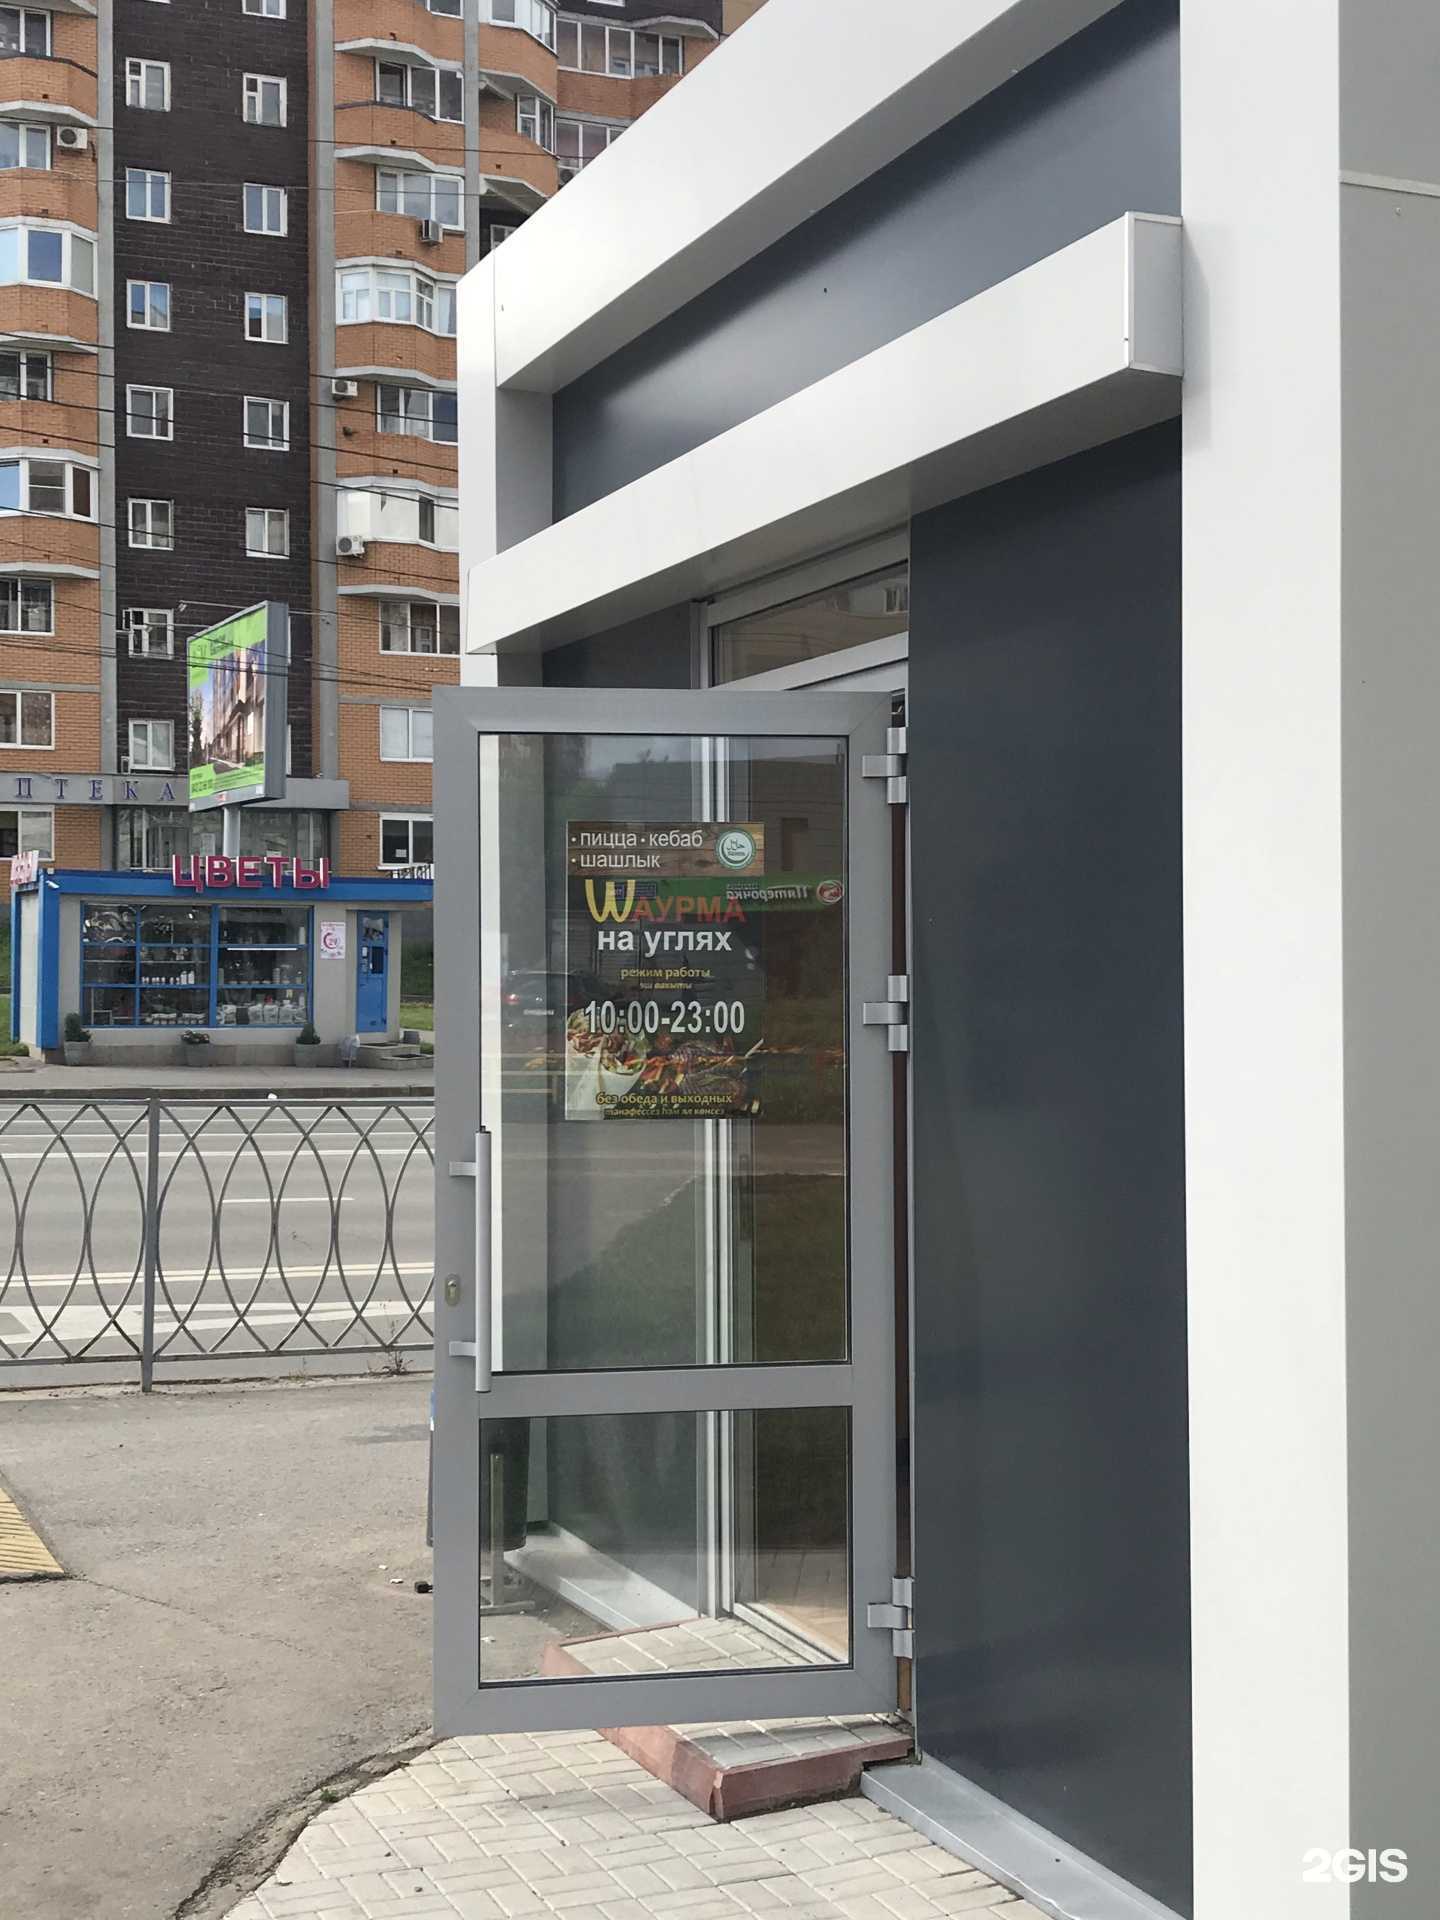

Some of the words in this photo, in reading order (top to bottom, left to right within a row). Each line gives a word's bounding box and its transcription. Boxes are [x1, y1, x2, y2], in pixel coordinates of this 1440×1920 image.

[580, 832, 637, 849] пицца
[649, 830, 703, 847] кебаб
[580, 854, 661, 868] шашлык
[172, 854, 331, 893] ЦВЕТЫ
[598, 930, 634, 951] на
[644, 931, 732, 958] углях
[621, 968, 662, 980] режим
[665, 967, 712, 980] работы
[585, 1000, 745, 1034] 10:00-23:00
[596, 1092, 619, 1104] без
[620, 1093, 658, 1105] обеда
[660, 1094, 668, 1104] и
[671, 1094, 733, 1106] выходных
